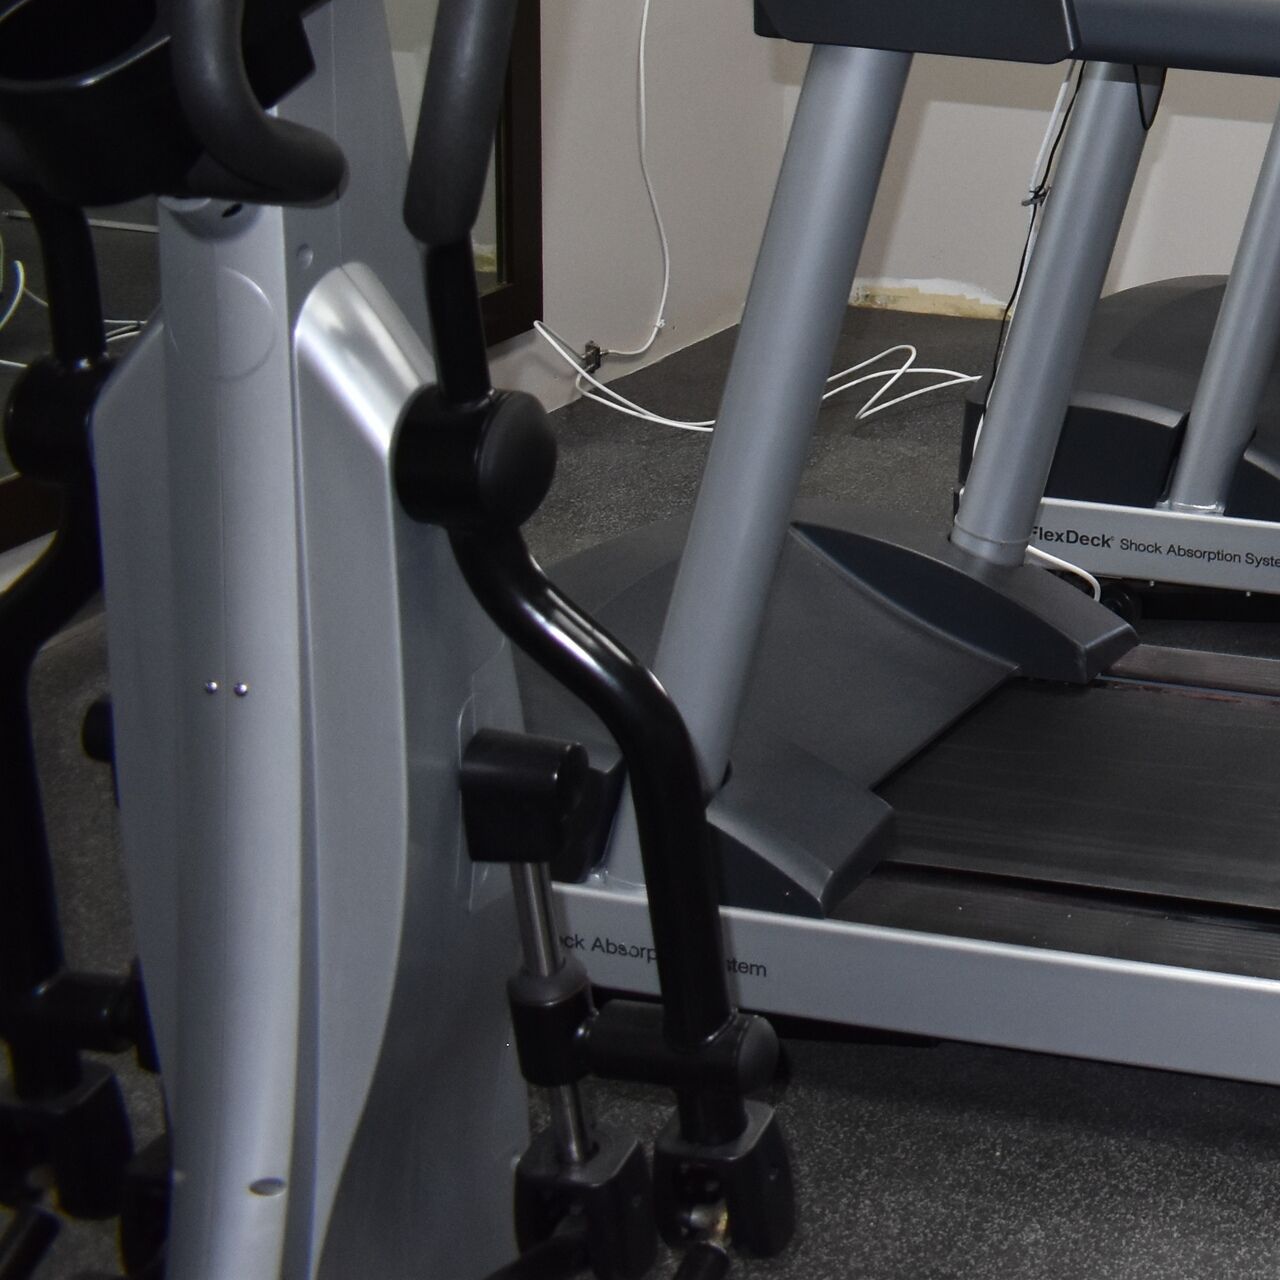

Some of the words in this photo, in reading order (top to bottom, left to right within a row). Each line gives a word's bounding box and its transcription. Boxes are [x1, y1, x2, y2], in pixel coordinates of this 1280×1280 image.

[1119, 537, 1163, 555] Shock
[1166, 544, 1242, 564] Absorption
[591, 936, 657, 964] Absorp
